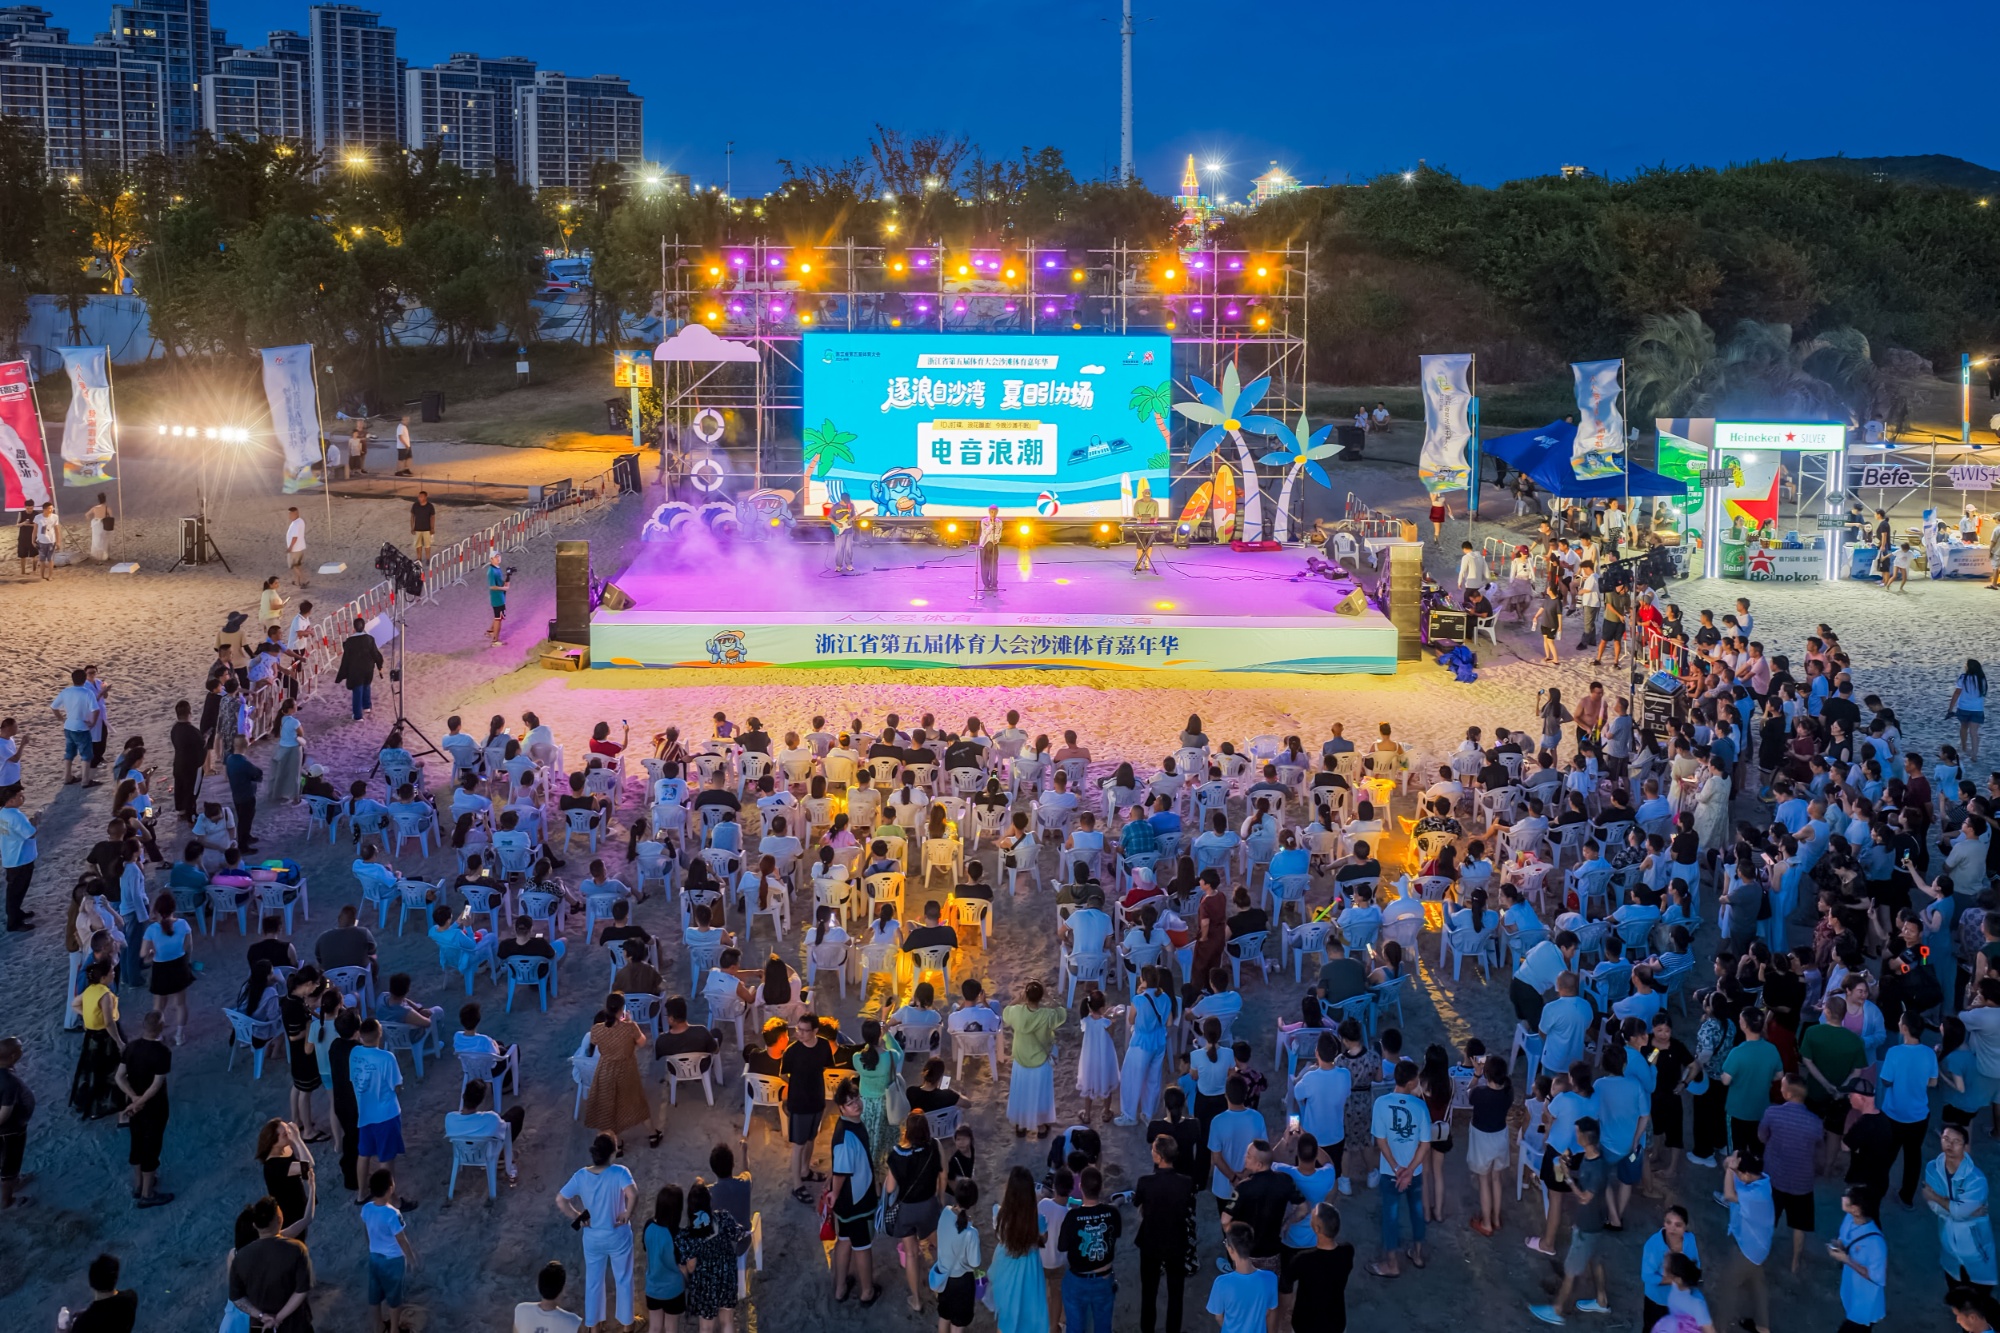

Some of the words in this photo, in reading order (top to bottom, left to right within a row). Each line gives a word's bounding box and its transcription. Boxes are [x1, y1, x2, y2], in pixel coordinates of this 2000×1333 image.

[927, 356, 1049, 367] 浙江省第五届体育大会沙滩体育嘉年华
[1000, 379, 1095, 410] 夏日引力场
[1729, 432, 1780, 443] Heineken
[1801, 433, 1826, 444] SILVER
[931, 437, 1044, 466] 电音浪潮
[815, 633, 1180, 656] 浙江省第五届体育大会沙滩体育嘉年华
